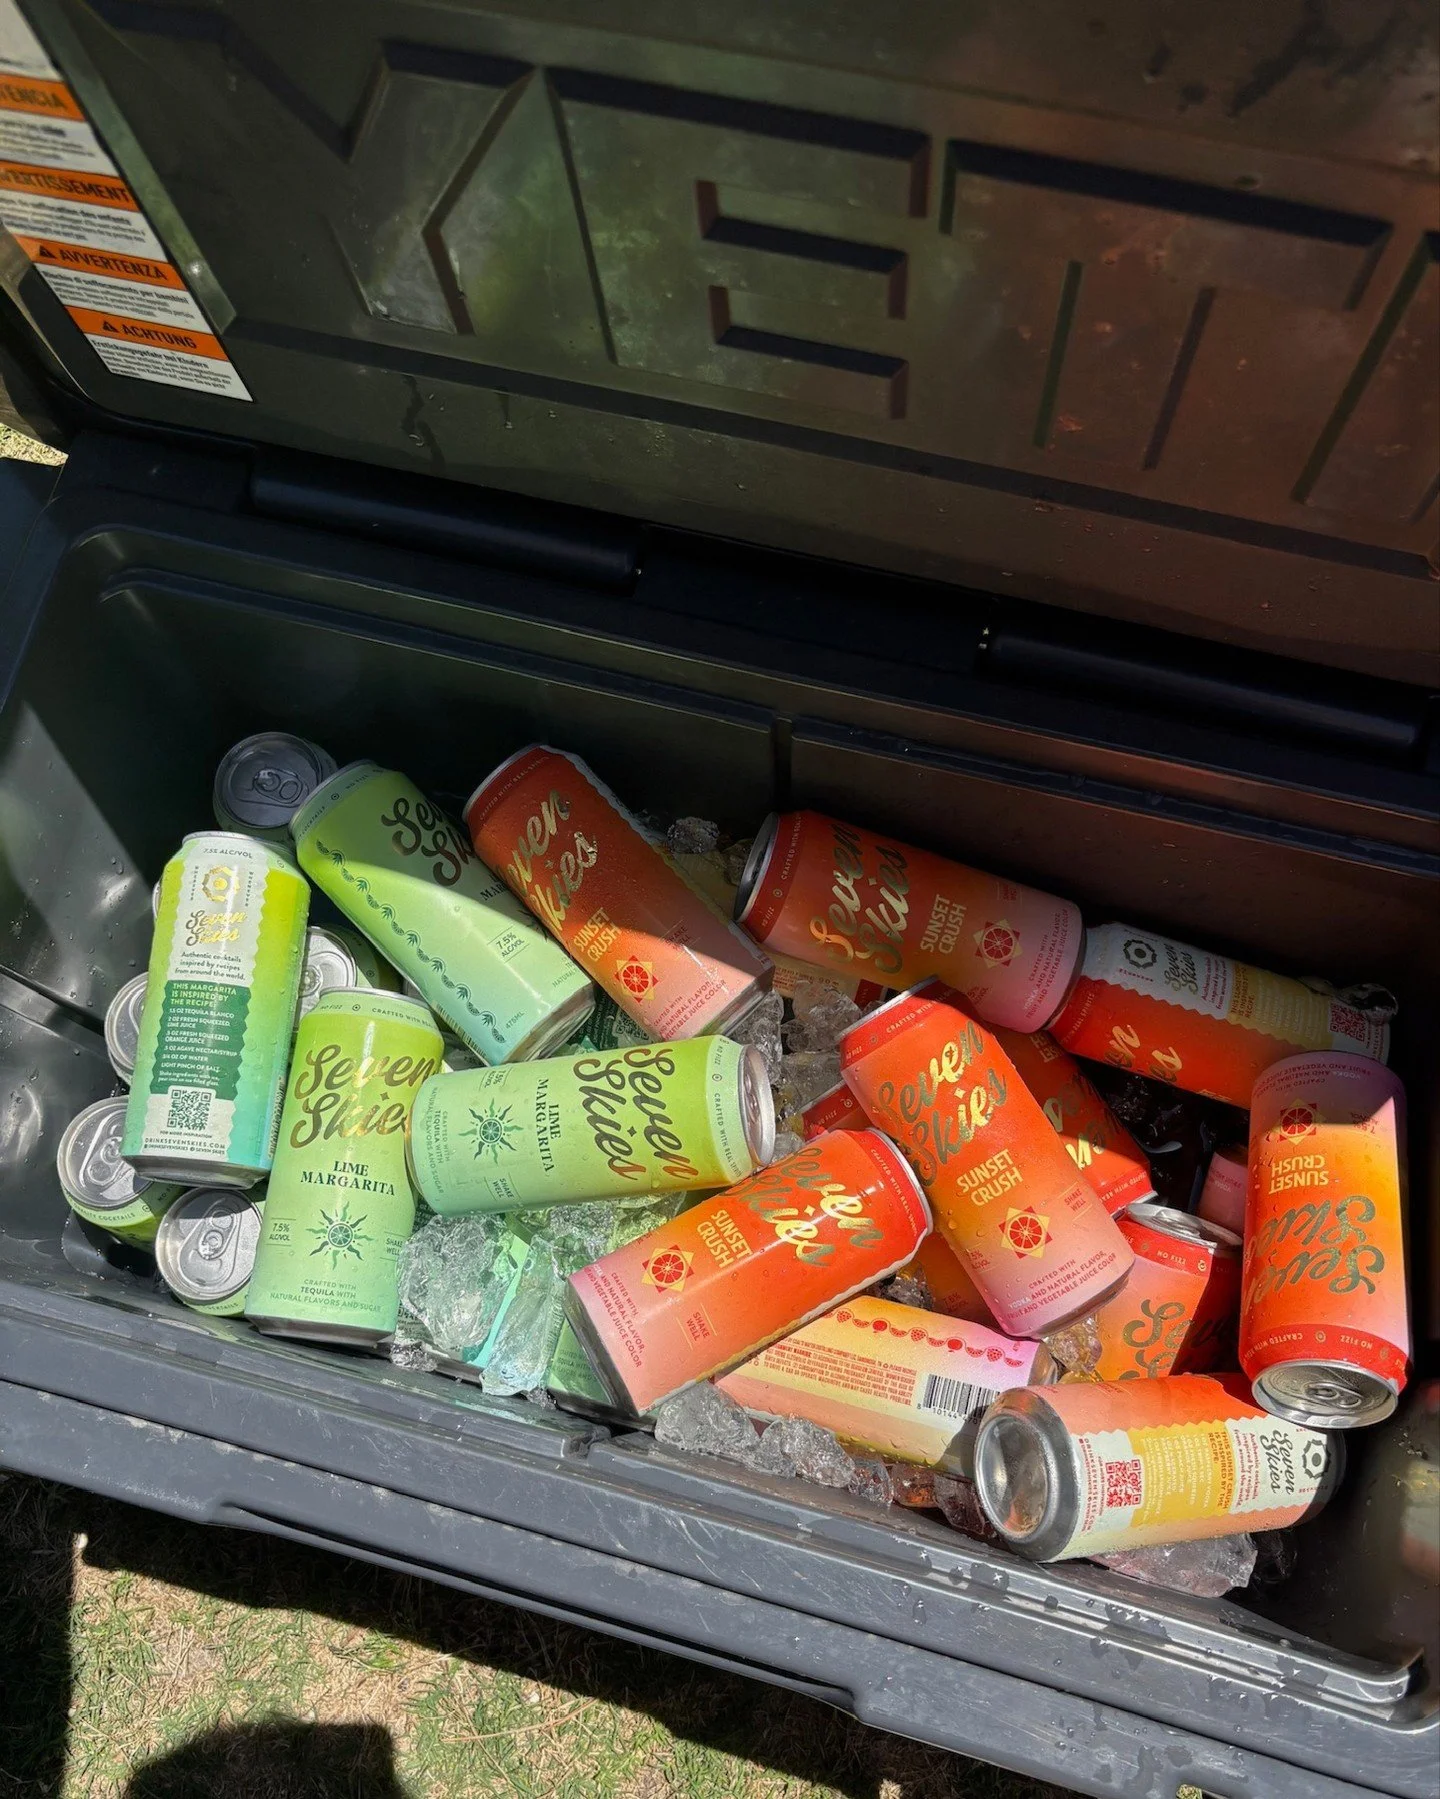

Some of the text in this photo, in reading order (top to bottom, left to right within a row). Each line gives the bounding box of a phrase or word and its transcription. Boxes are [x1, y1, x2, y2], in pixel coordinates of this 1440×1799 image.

[59, 250, 168, 281] AVVERTENZA
[121, 323, 197, 349] ACHTUNG
[809, 823, 864, 964] Seven
[186, 909, 248, 930] Seven
[573, 907, 610, 952] SUNSET
[920, 894, 951, 953] SUNSET
[939, 903, 967, 955] CRUSH
[496, 932, 517, 949] 7.5%
[501, 939, 525, 957] ALC/VOL
[587, 923, 622, 962] CRUSH
[180, 991, 216, 1000] INSPIRED
[190, 984, 237, 995] MARGARITA
[372, 1007, 404, 1019] CRAFTED
[666, 1004, 688, 1026] NATURAL
[689, 999, 705, 1016] JUICE
[885, 1003, 933, 1033] CRAFTED WITH
[294, 1044, 437, 1100] Seven
[878, 1020, 985, 1139] Seven
[535, 1078, 555, 1172] MARGARITA
[548, 1104, 561, 1140] LIME
[573, 1058, 647, 1181] Skies
[623, 1048, 699, 1180] Seven
[714, 1092, 725, 1127] CRAFTED
[720, 1128, 729, 1146] WITH
[910, 1067, 1008, 1188] Skies
[145, 1138, 225, 1149] DRINKSEVENSKIES.COM
[333, 1160, 369, 1177] LIME
[956, 1149, 1015, 1193] SUNSET
[1271, 1155, 1326, 1178] CRUSH
[300, 1171, 395, 1196] MARGARITA
[492, 1180, 504, 1198] WELL
[500, 1178, 514, 1198] SHAKE
[890, 1177, 902, 1196] WITH
[971, 1167, 1024, 1207] CRUSH
[1268, 1171, 1329, 1195] SUNSET
[1064, 1188, 1083, 1205] SHAKE
[1070, 1199, 1086, 1213] WELL
[98, 1212, 136, 1221] COCKTAILS
[272, 1223, 290, 1232] 7.5%
[696, 1221, 734, 1268] CRUSH
[711, 1209, 754, 1260] SUNSET
[1156, 1251, 1187, 1266] NO FIZZ
[304, 1279, 337, 1288] CRAFTED
[1024, 1253, 1116, 1317] AND VEGETABLE JUICE COLOR
[1029, 1260, 1076, 1289] CRAFTED WITH
[1031, 1288, 1046, 1300] AND
[1047, 1270, 1080, 1291] NATURAL
[270, 1292, 301, 1302] NATURAL
[304, 1296, 340, 1307] FLAVORS
[300, 1286, 357, 1299] TEQUILA WITH
[600, 1276, 609, 1288] AND
[607, 1287, 628, 1320] NATURAL
[611, 1272, 639, 1316] CRAFTED WITH
[594, 1282, 642, 1368] VEGETABLE JUICE COLOR
[686, 1318, 701, 1342] WELL
[692, 1311, 711, 1339] SHAKE
[1270, 1332, 1303, 1345] CRAFTED
[1340, 1335, 1359, 1345] FIZZ
[1361, 1340, 1373, 1349] NO
[1221, 1432, 1230, 1449] THIS
[1249, 1433, 1260, 1469] Authentic
[1218, 1441, 1226, 1478] INSPIRED
[1260, 1435, 1282, 1494] Skies
[1272, 1430, 1295, 1495] Seven
[1221, 1480, 1226, 1490] BY
[1223, 1483, 1232, 1509] CRUSH
